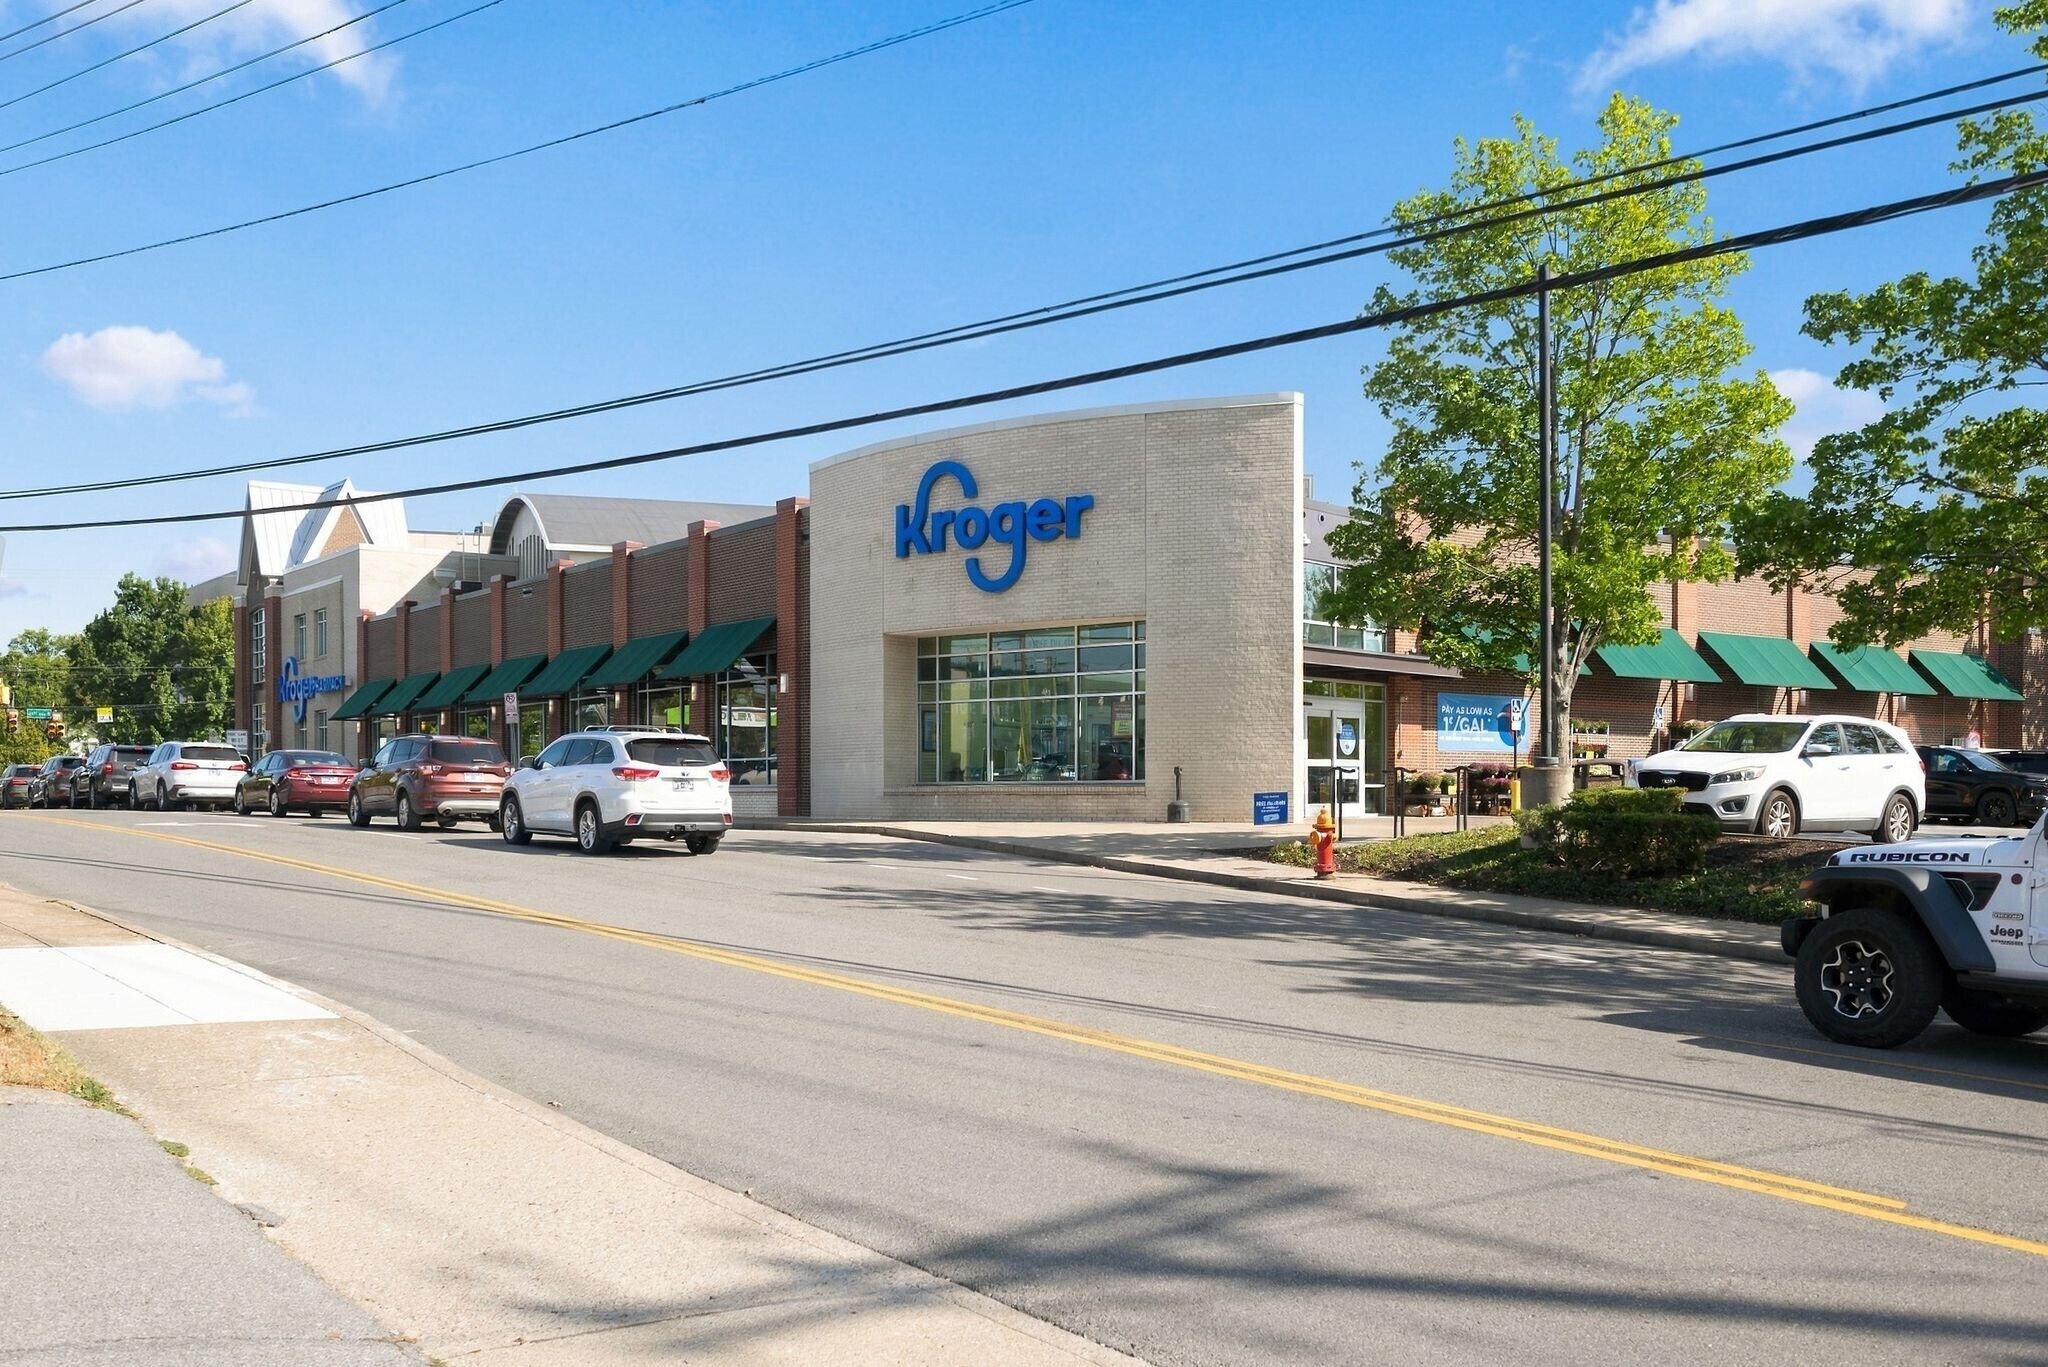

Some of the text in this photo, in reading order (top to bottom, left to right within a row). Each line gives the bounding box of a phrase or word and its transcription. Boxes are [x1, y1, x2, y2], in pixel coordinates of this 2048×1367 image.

[1441, 704, 1493, 716] PAY AS LOW AS
[1850, 853, 1970, 863] RUBICON
[1990, 924, 2024, 940] Jeep
